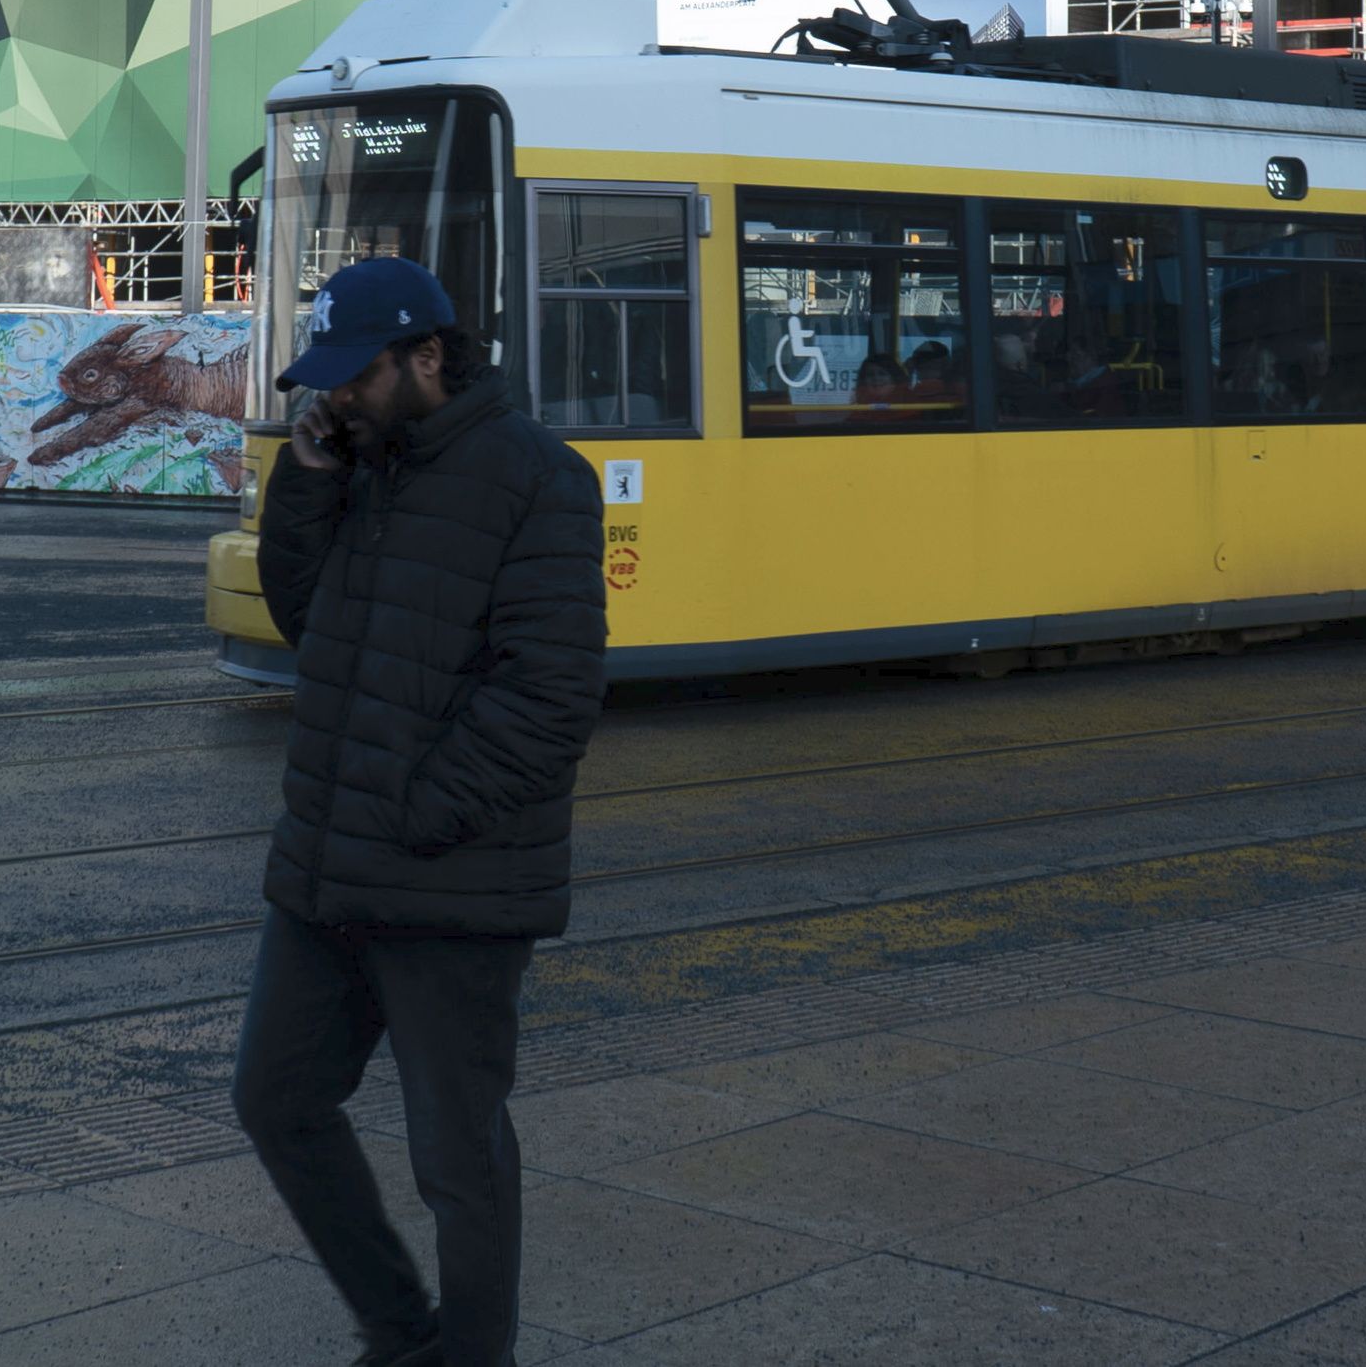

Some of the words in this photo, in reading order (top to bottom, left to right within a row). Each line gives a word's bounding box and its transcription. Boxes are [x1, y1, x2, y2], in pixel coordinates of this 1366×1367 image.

[680, 2, 691, 11] AM
[608, 525, 638, 543] BVG
[609, 562, 637, 575] VBB
